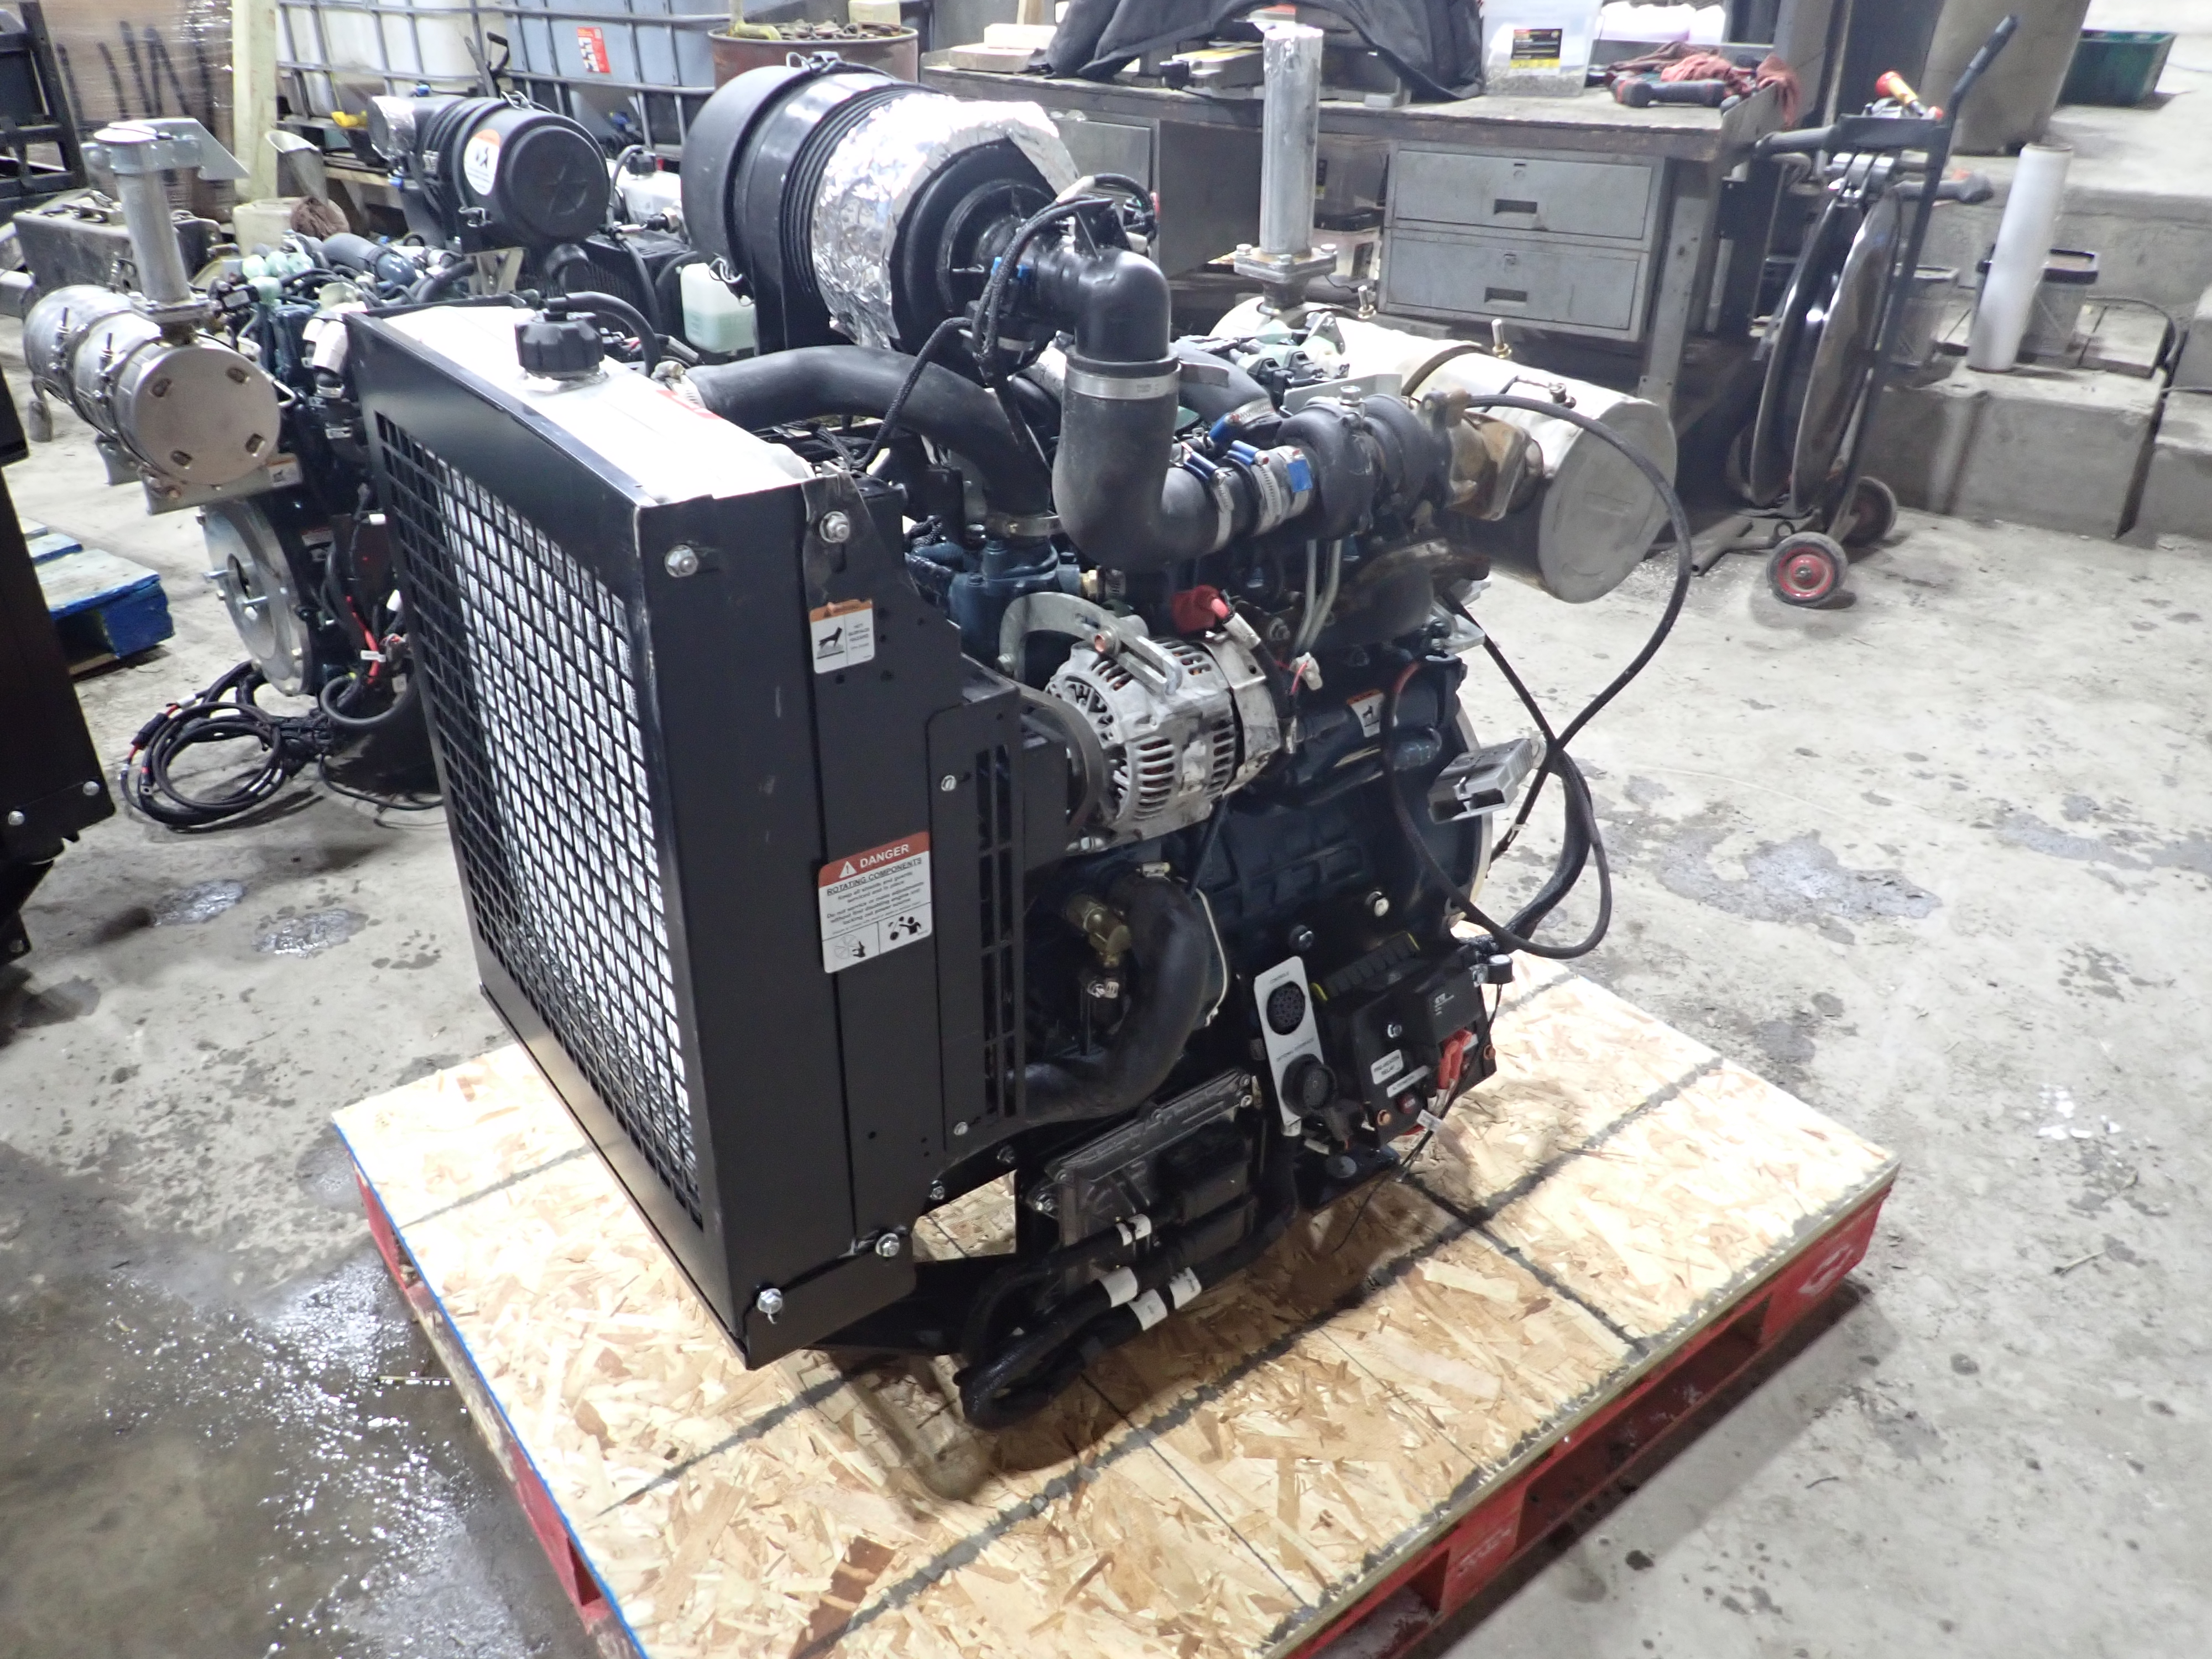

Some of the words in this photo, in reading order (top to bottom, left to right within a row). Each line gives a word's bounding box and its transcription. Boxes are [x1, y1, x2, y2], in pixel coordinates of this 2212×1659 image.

[860, 844, 909, 868] DANGER
[827, 877, 865, 895] ROTATING
[868, 857, 922, 881] COMPONENTS
